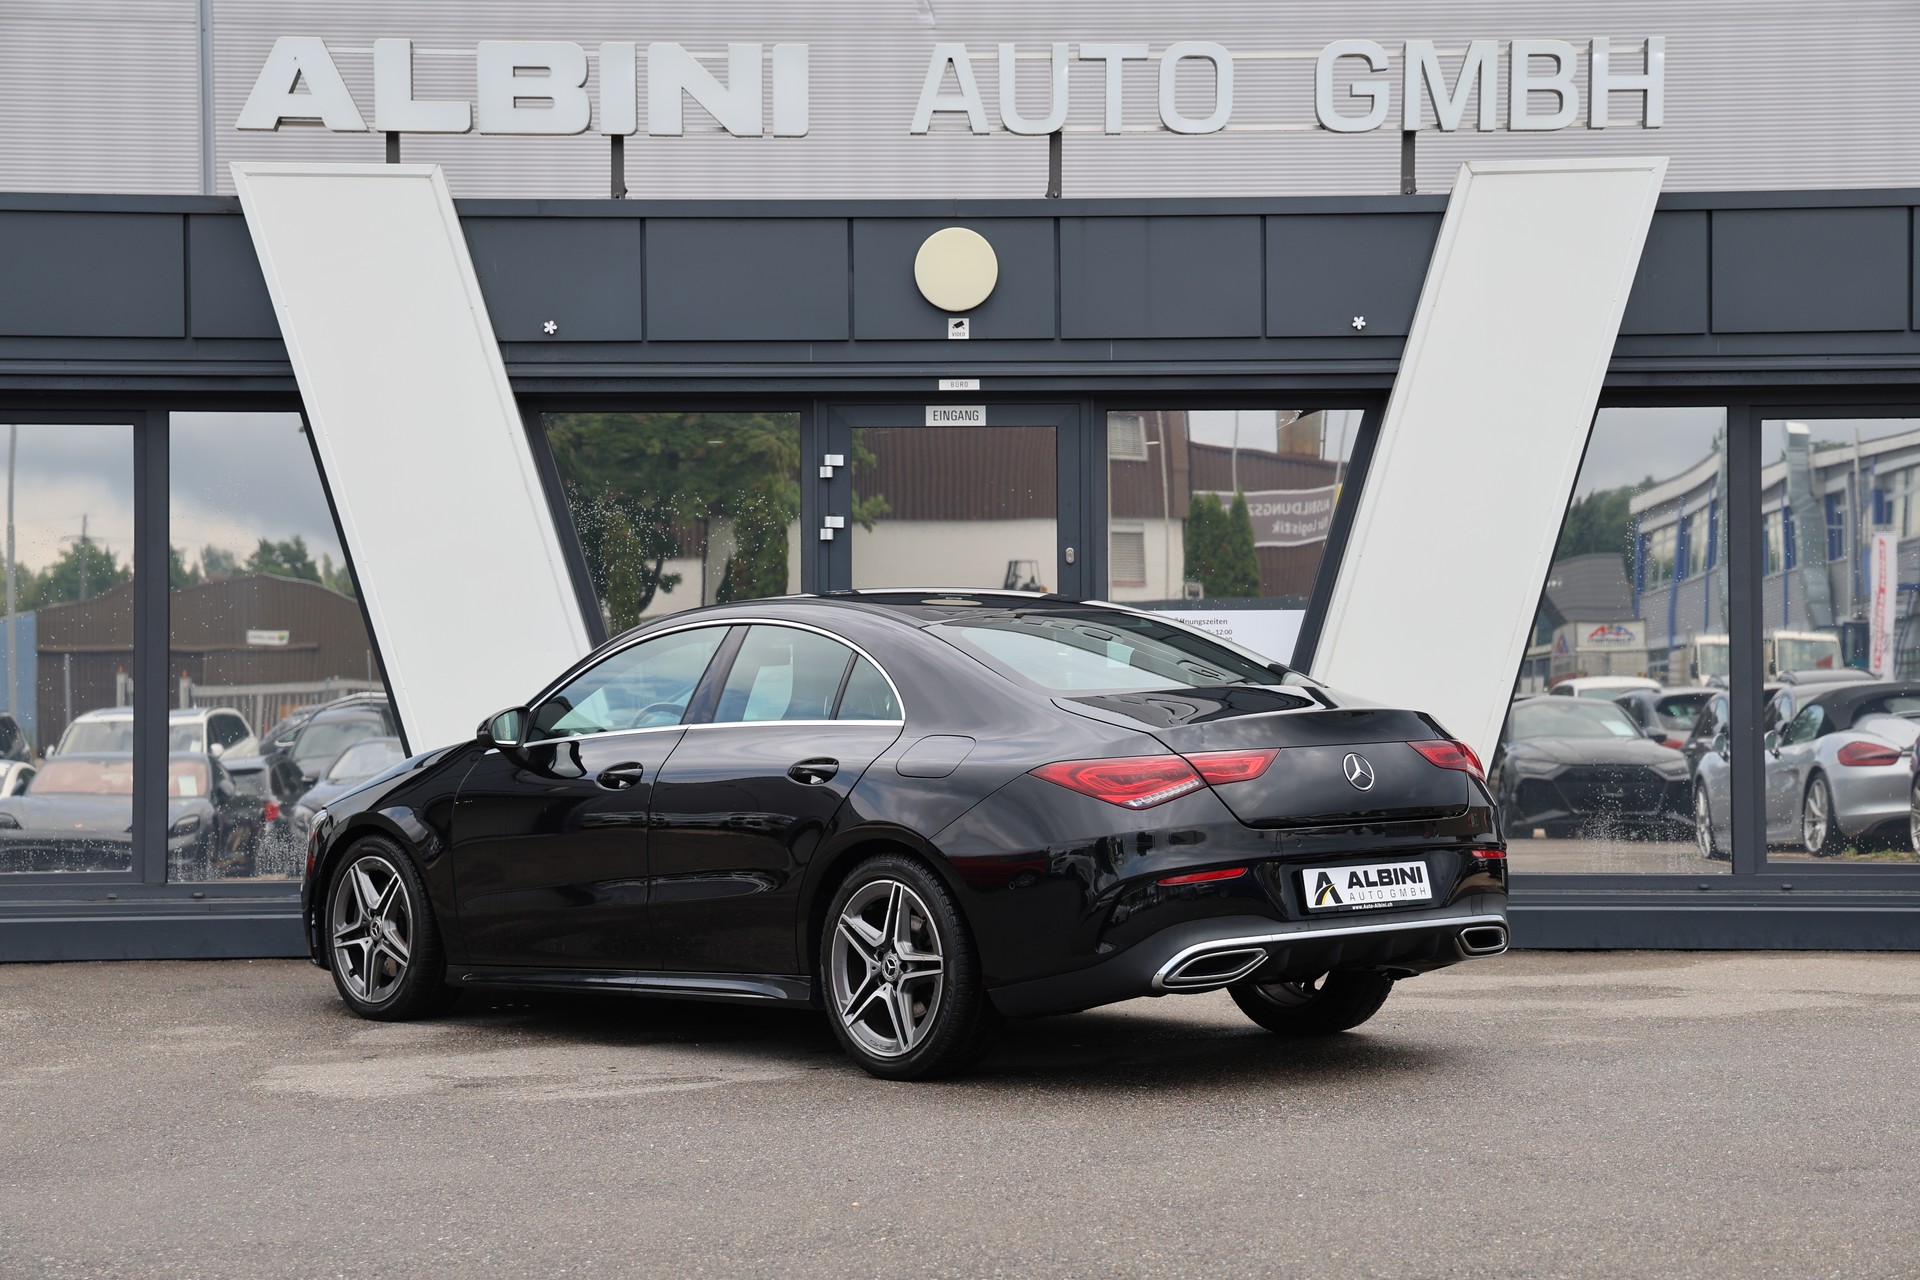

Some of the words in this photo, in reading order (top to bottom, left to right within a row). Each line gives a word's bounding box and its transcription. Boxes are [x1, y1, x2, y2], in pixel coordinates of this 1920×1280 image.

[234, 36, 810, 138] ALBINI
[909, 40, 1235, 136] AUTO
[1314, 36, 1666, 134] GMBH
[950, 380, 969, 388] BÜRO
[933, 409, 979, 421] EINGANG
[1347, 866, 1424, 889] ALBINI
[1349, 889, 1384, 902] AUTO
[1389, 886, 1427, 898] GMBH
[1351, 902, 1394, 910] www.Auto-Albini.ch
